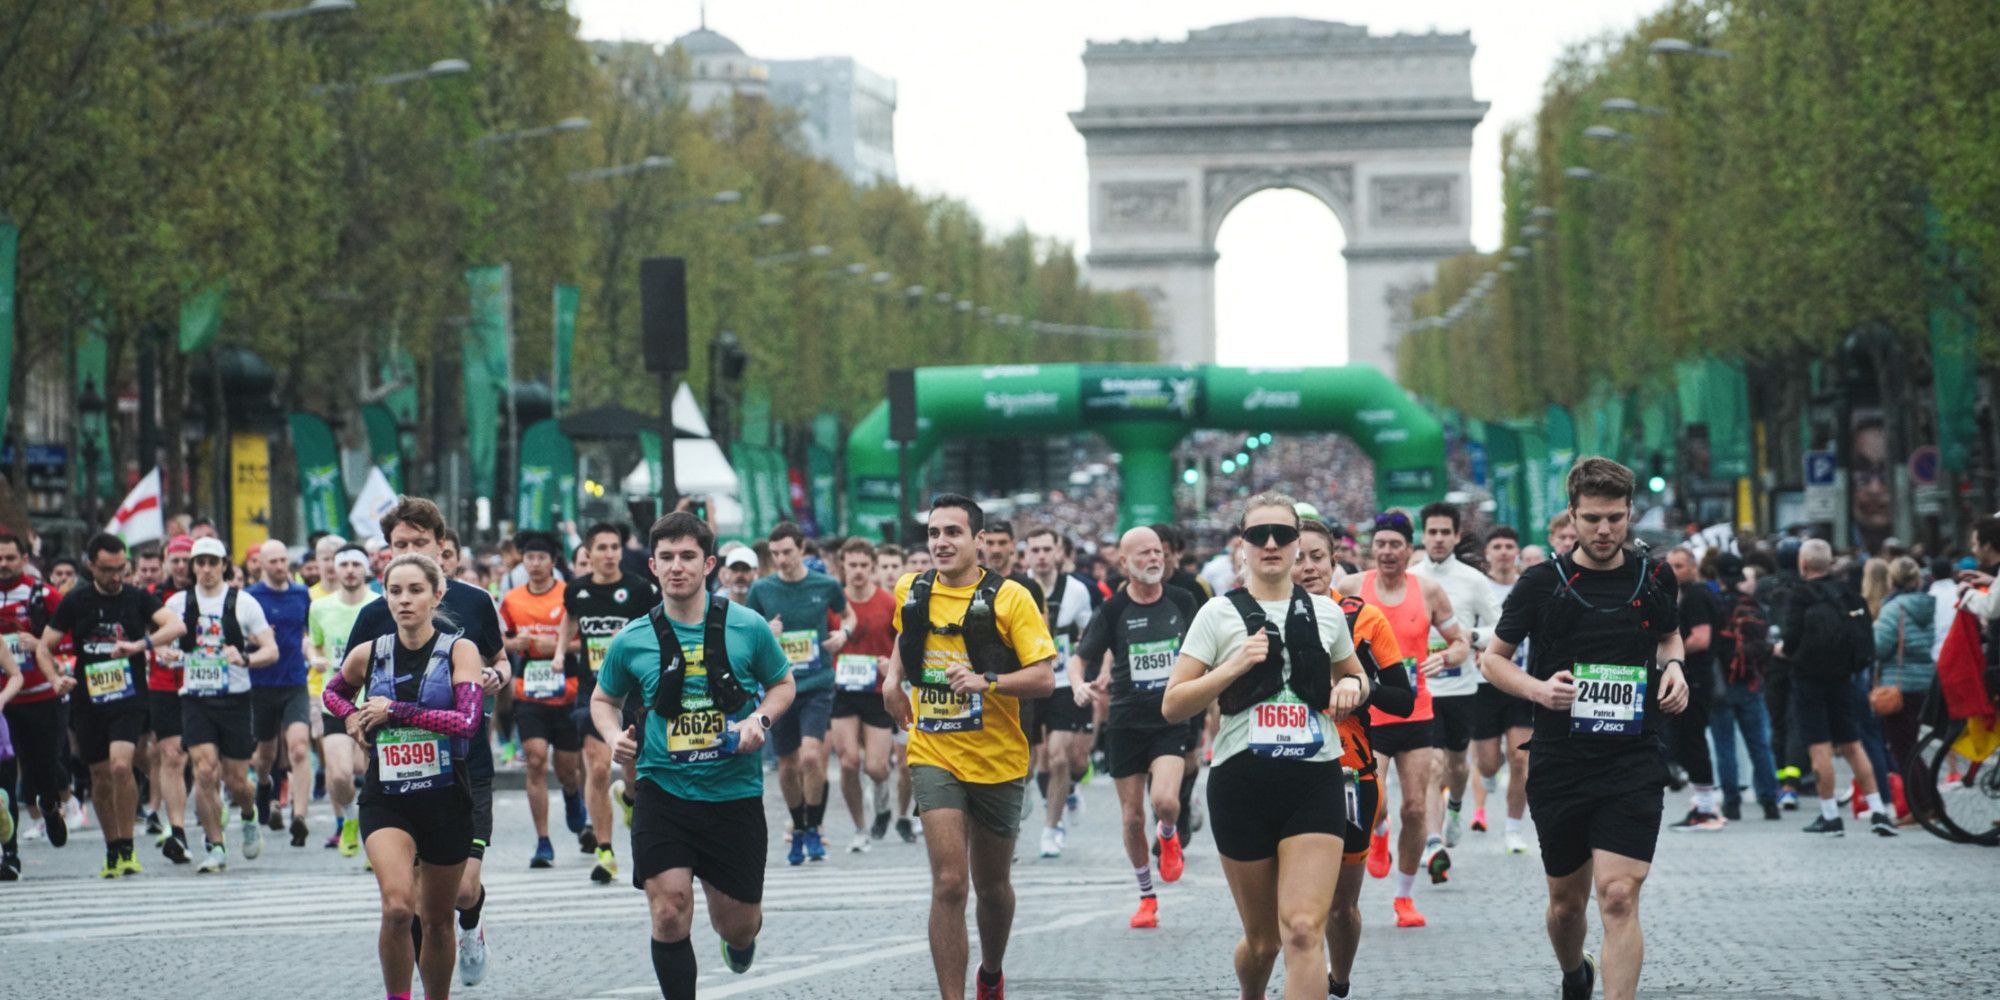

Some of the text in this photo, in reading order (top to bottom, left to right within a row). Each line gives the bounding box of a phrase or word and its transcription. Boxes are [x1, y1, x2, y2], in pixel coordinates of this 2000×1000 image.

[1134, 653, 1172, 671] 28591
[1589, 663, 1634, 675] Schneider
[1577, 681, 1633, 705] 24408
[1254, 704, 1307, 728] 16658
[1593, 709, 1615, 717] Patrick
[671, 713, 724, 736] 26625
[382, 742, 436, 767] 16399
[396, 770, 423, 779] Michelle
